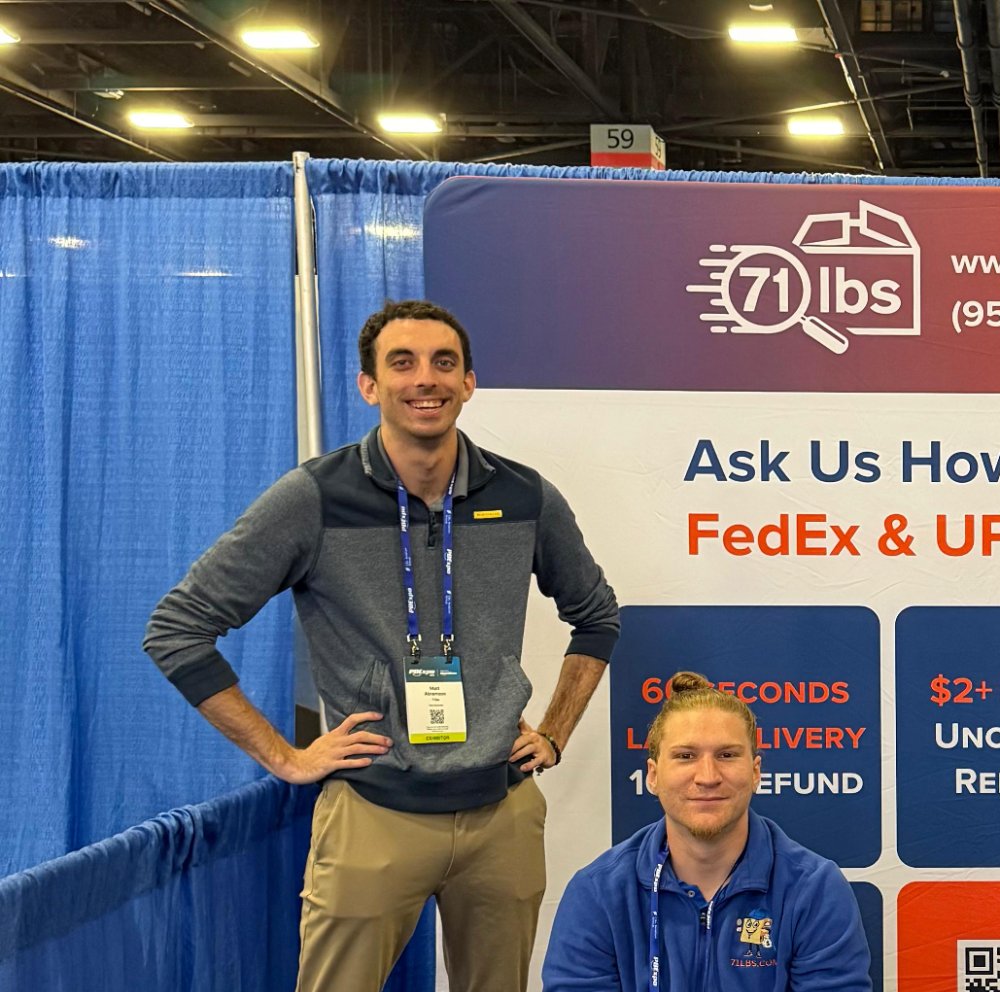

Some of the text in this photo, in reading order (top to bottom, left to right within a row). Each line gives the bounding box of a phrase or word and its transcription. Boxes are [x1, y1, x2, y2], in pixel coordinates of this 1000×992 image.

[608, 129, 634, 149] 59
[739, 266, 902, 315] 71 lbs
[684, 440, 791, 483] Ask
[810, 440, 880, 483] Us
[687, 513, 860, 556] FedEx
[877, 514, 917, 557] &
[930, 674, 993, 707] $2+
[756, 772, 864, 795] EFUND
